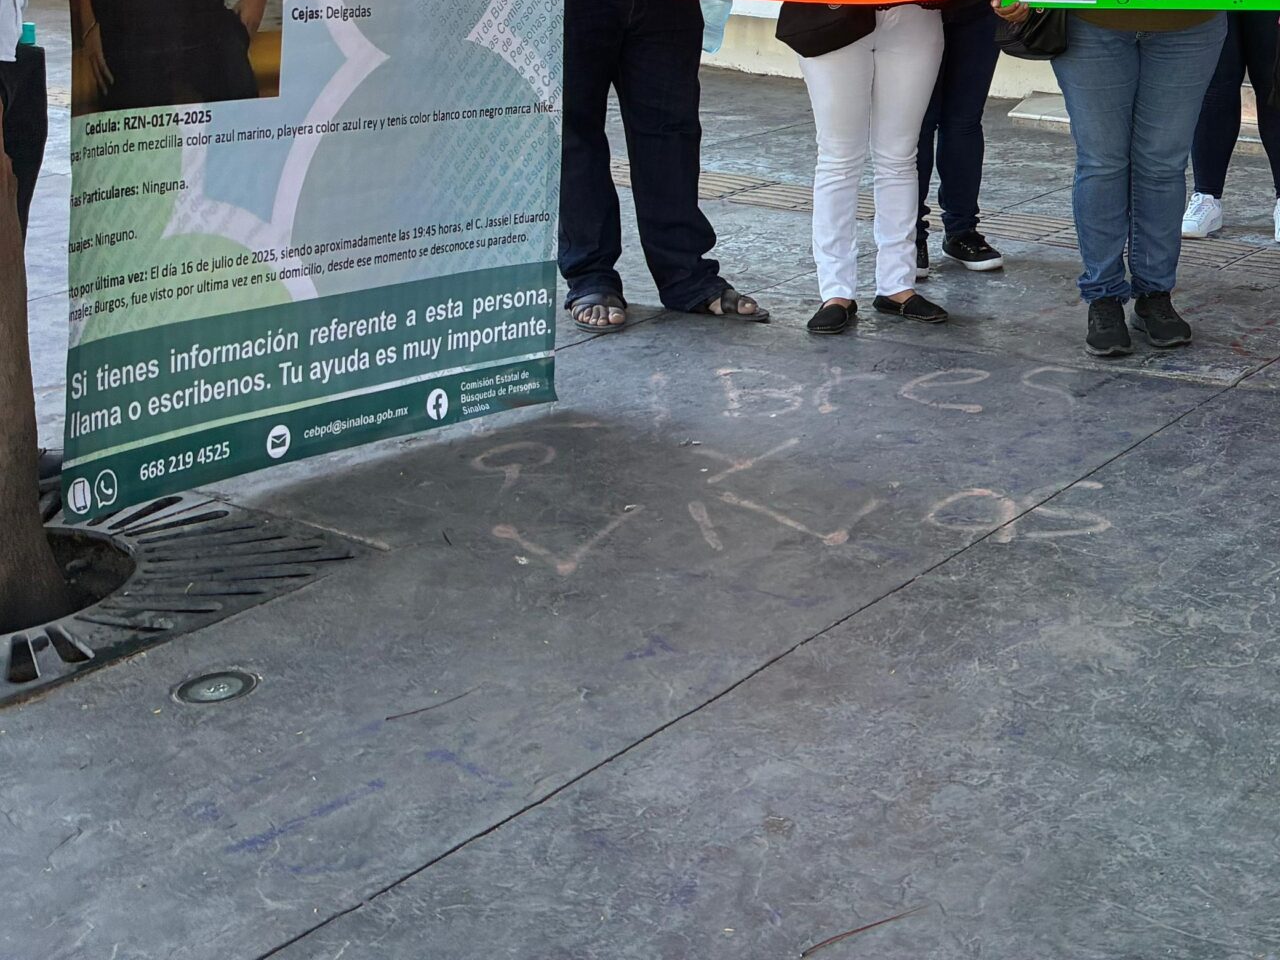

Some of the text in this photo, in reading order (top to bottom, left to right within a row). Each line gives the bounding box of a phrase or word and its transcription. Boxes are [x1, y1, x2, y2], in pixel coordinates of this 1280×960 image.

[85, 110, 212, 136] Cedula: RZN-0174-2025
[71, 288, 553, 400] Si tienes información referente a esta persona,
[70, 317, 552, 439] llama o escribenos. Tu ayuda es muy importante.
[461, 370, 529, 391] Comisión Estatal de
[461, 381, 540, 404] Búsqueda de Personas
[303, 405, 409, 439] cebpd@sinaloa.gob.mx
[462, 402, 490, 415] Sinaloa
[140, 441, 230, 481] 668 219 4525
